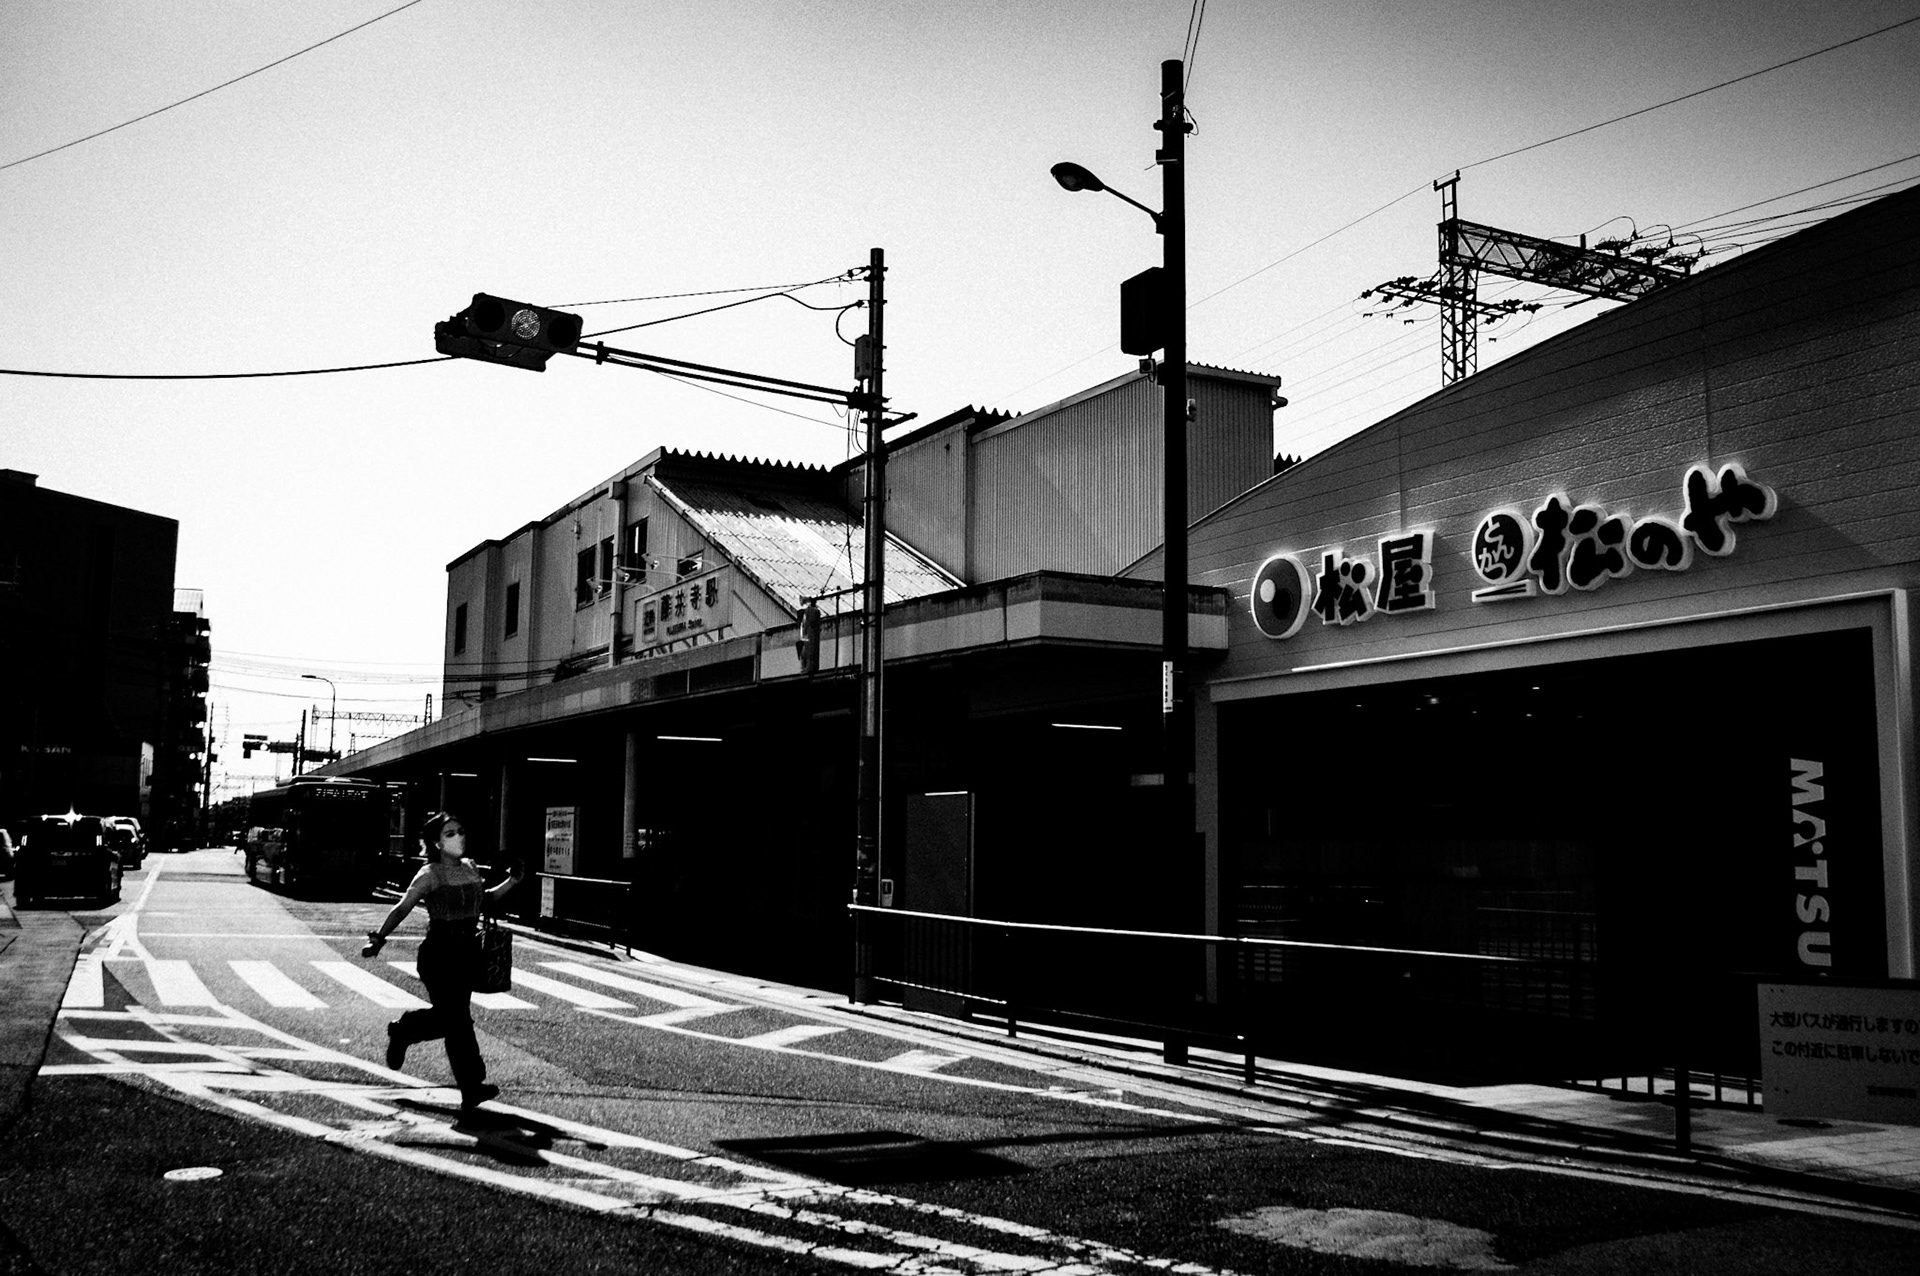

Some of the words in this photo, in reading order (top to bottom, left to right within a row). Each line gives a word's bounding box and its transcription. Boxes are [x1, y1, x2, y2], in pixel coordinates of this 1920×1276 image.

[1313, 532, 1430, 624] 松屋
[1531, 467, 1768, 593] 松のや
